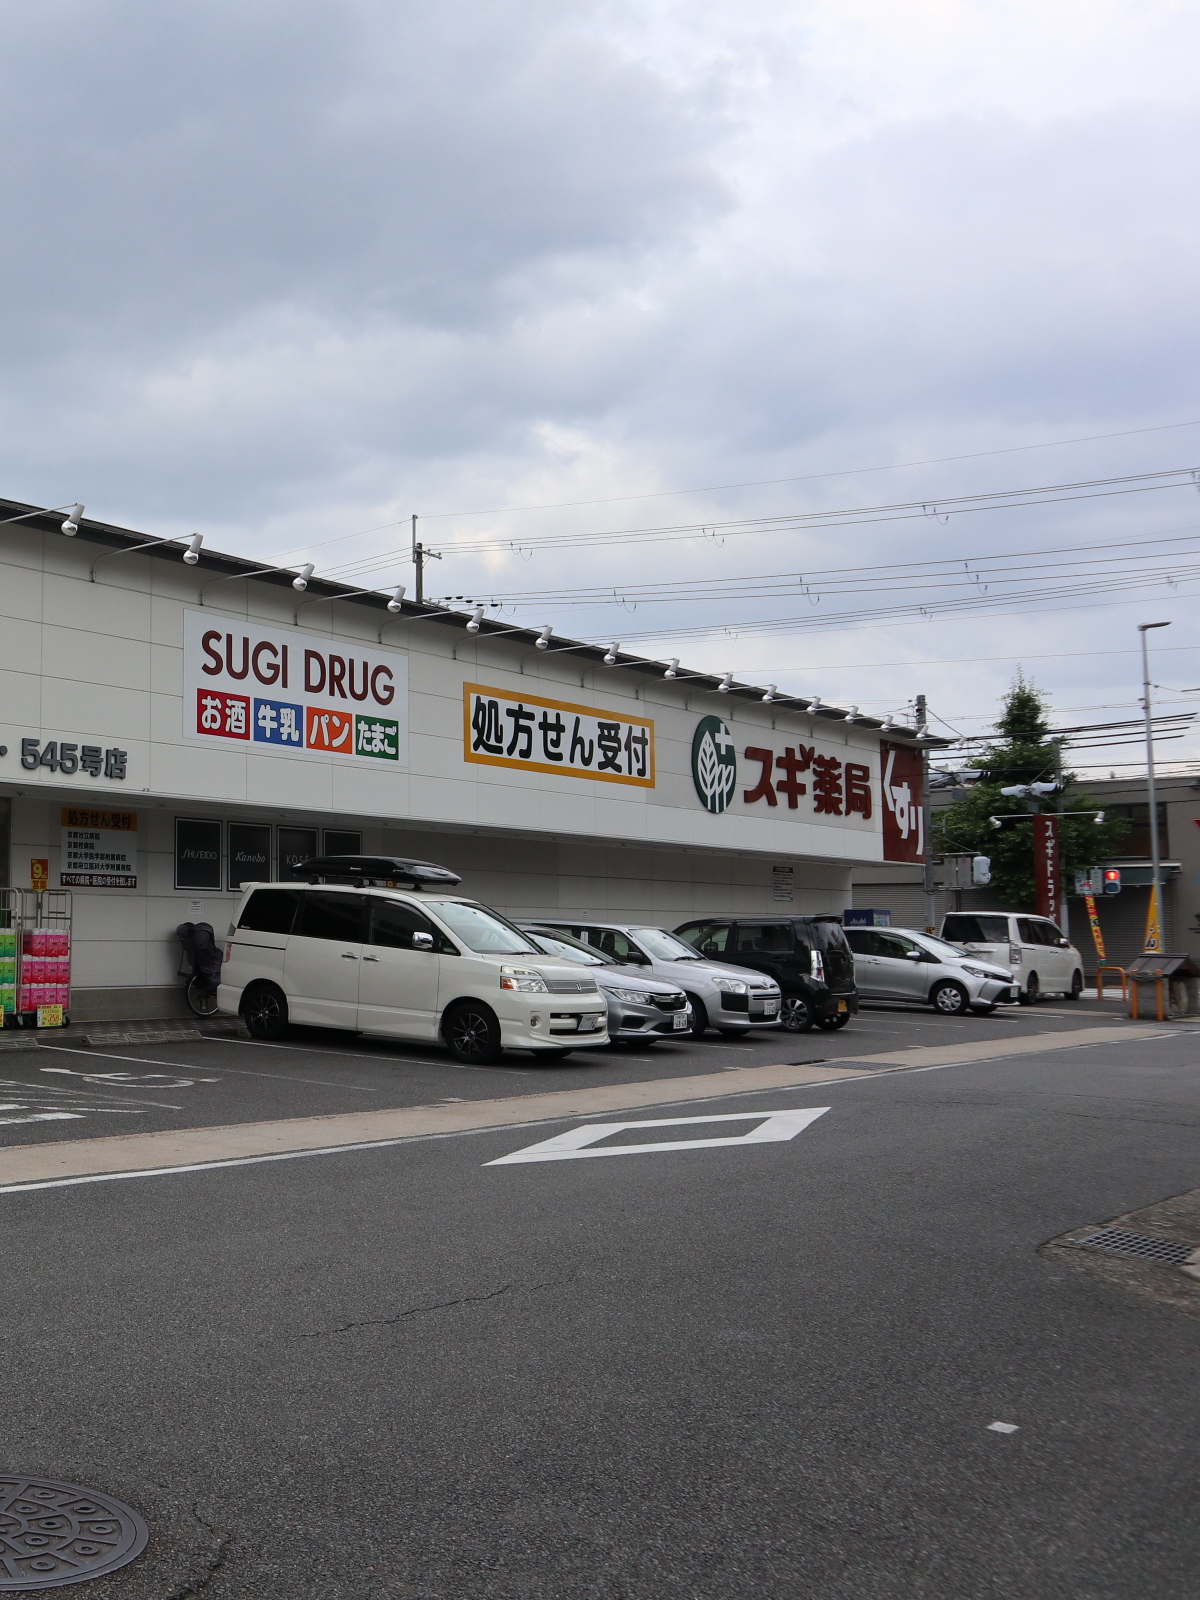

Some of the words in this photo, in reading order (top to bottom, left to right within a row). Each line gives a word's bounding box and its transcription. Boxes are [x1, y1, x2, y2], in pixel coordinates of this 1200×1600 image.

[201, 629, 288, 689] SUGI
[304, 649, 395, 706] DRUG
[201, 695, 246, 735] お酒
[257, 704, 300, 743] 牛乳
[309, 713, 350, 750] パン
[357, 720, 398, 756] たまご
[472, 695, 649, 777] 処方せん受付
[743, 743, 872, 820] スギ薬局
[882, 751, 923, 855] くすり
[68, 810, 132, 829] 処方せん受付
[181, 848, 217, 860] SHISEIDO
[235, 851, 266, 863] Kanebo
